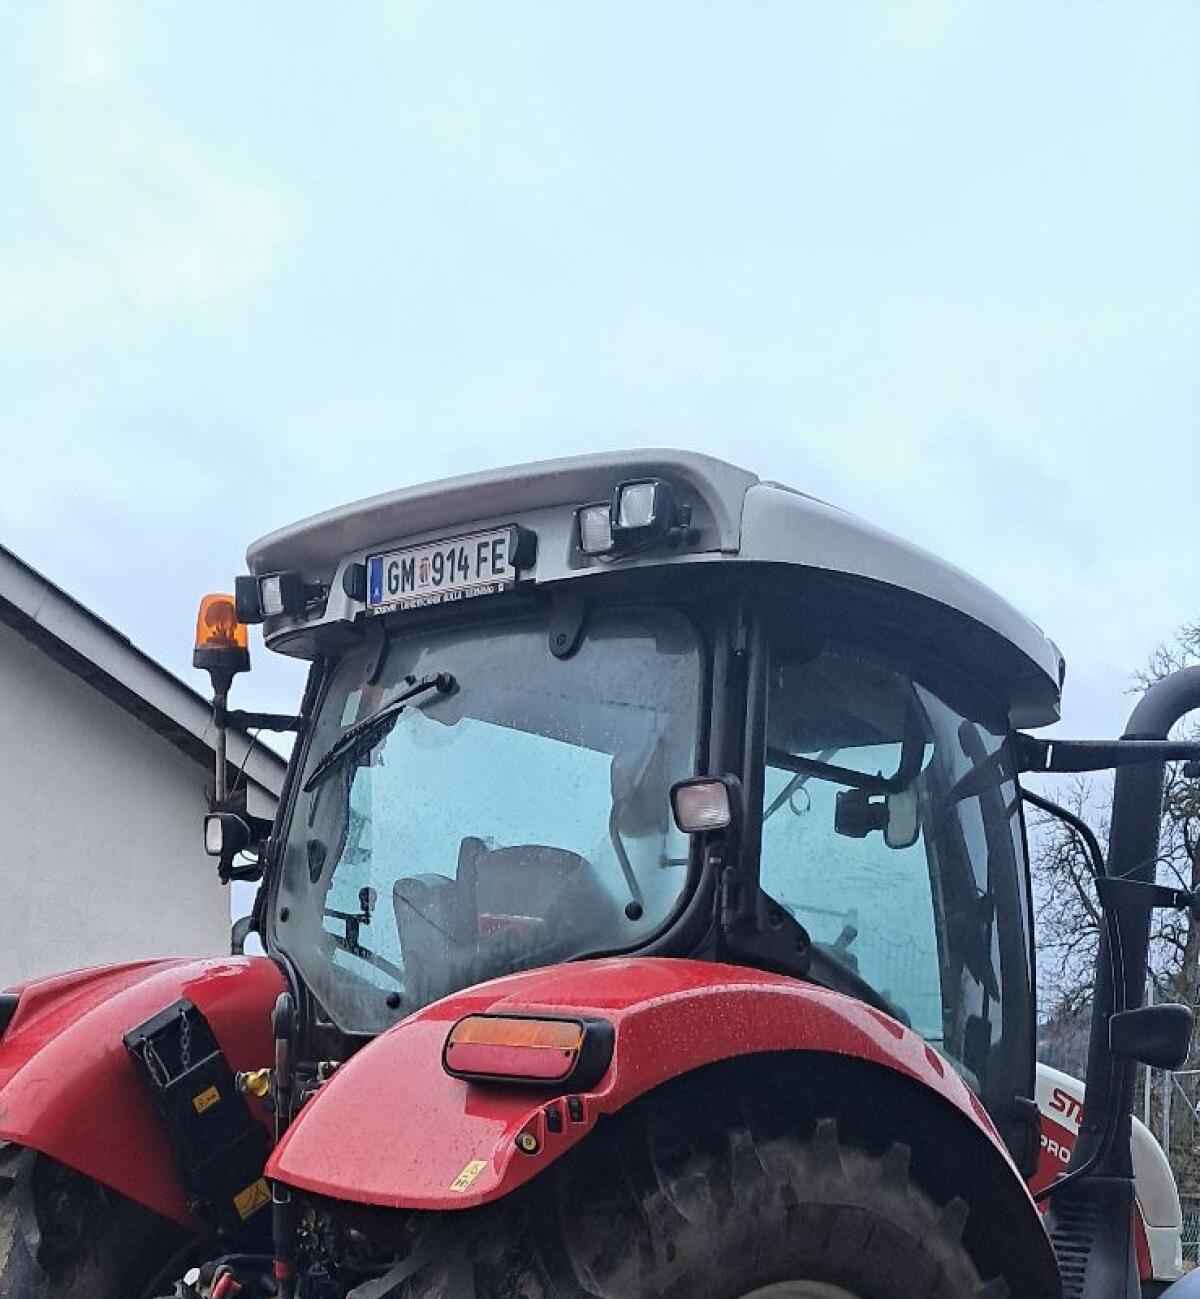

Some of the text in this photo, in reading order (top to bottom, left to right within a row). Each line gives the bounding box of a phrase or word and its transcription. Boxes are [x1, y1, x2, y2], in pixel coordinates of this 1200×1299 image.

[387, 538, 506, 595] GM 914 FE
